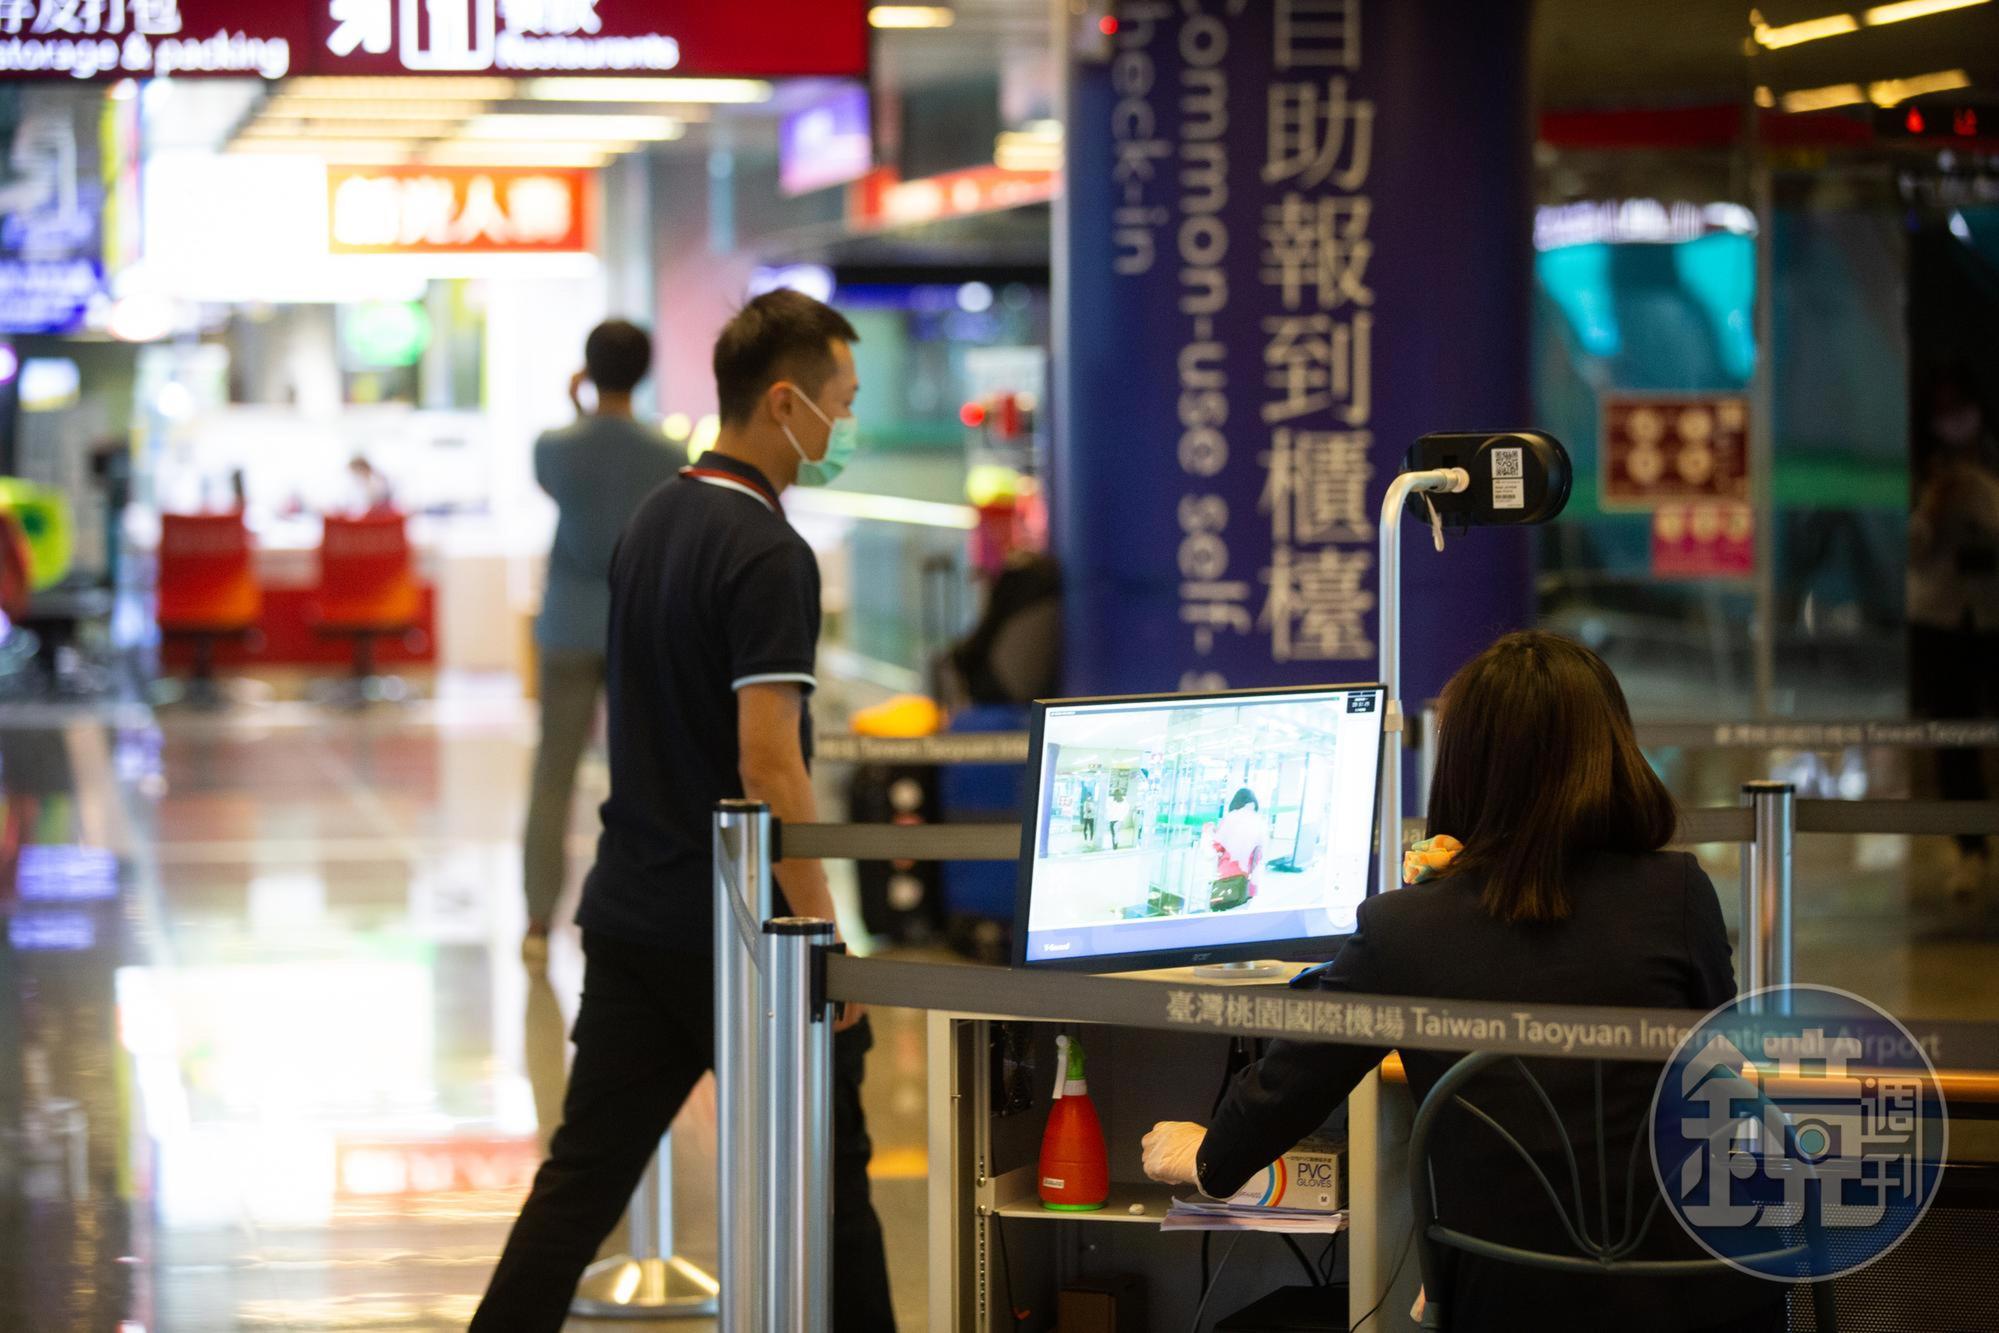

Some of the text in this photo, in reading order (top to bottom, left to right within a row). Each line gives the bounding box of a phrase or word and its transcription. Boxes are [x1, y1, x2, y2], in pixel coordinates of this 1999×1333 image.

[154, 28, 289, 79] packing
[1177, 0, 1247, 477] ommon-use
[1166, 990, 1941, 1062] 臺灣桃園國際機場 Taiwan Taoyuan International Airport
[1296, 1179, 1332, 1188] GLOVES
[1297, 1163, 1332, 1180] PVC
